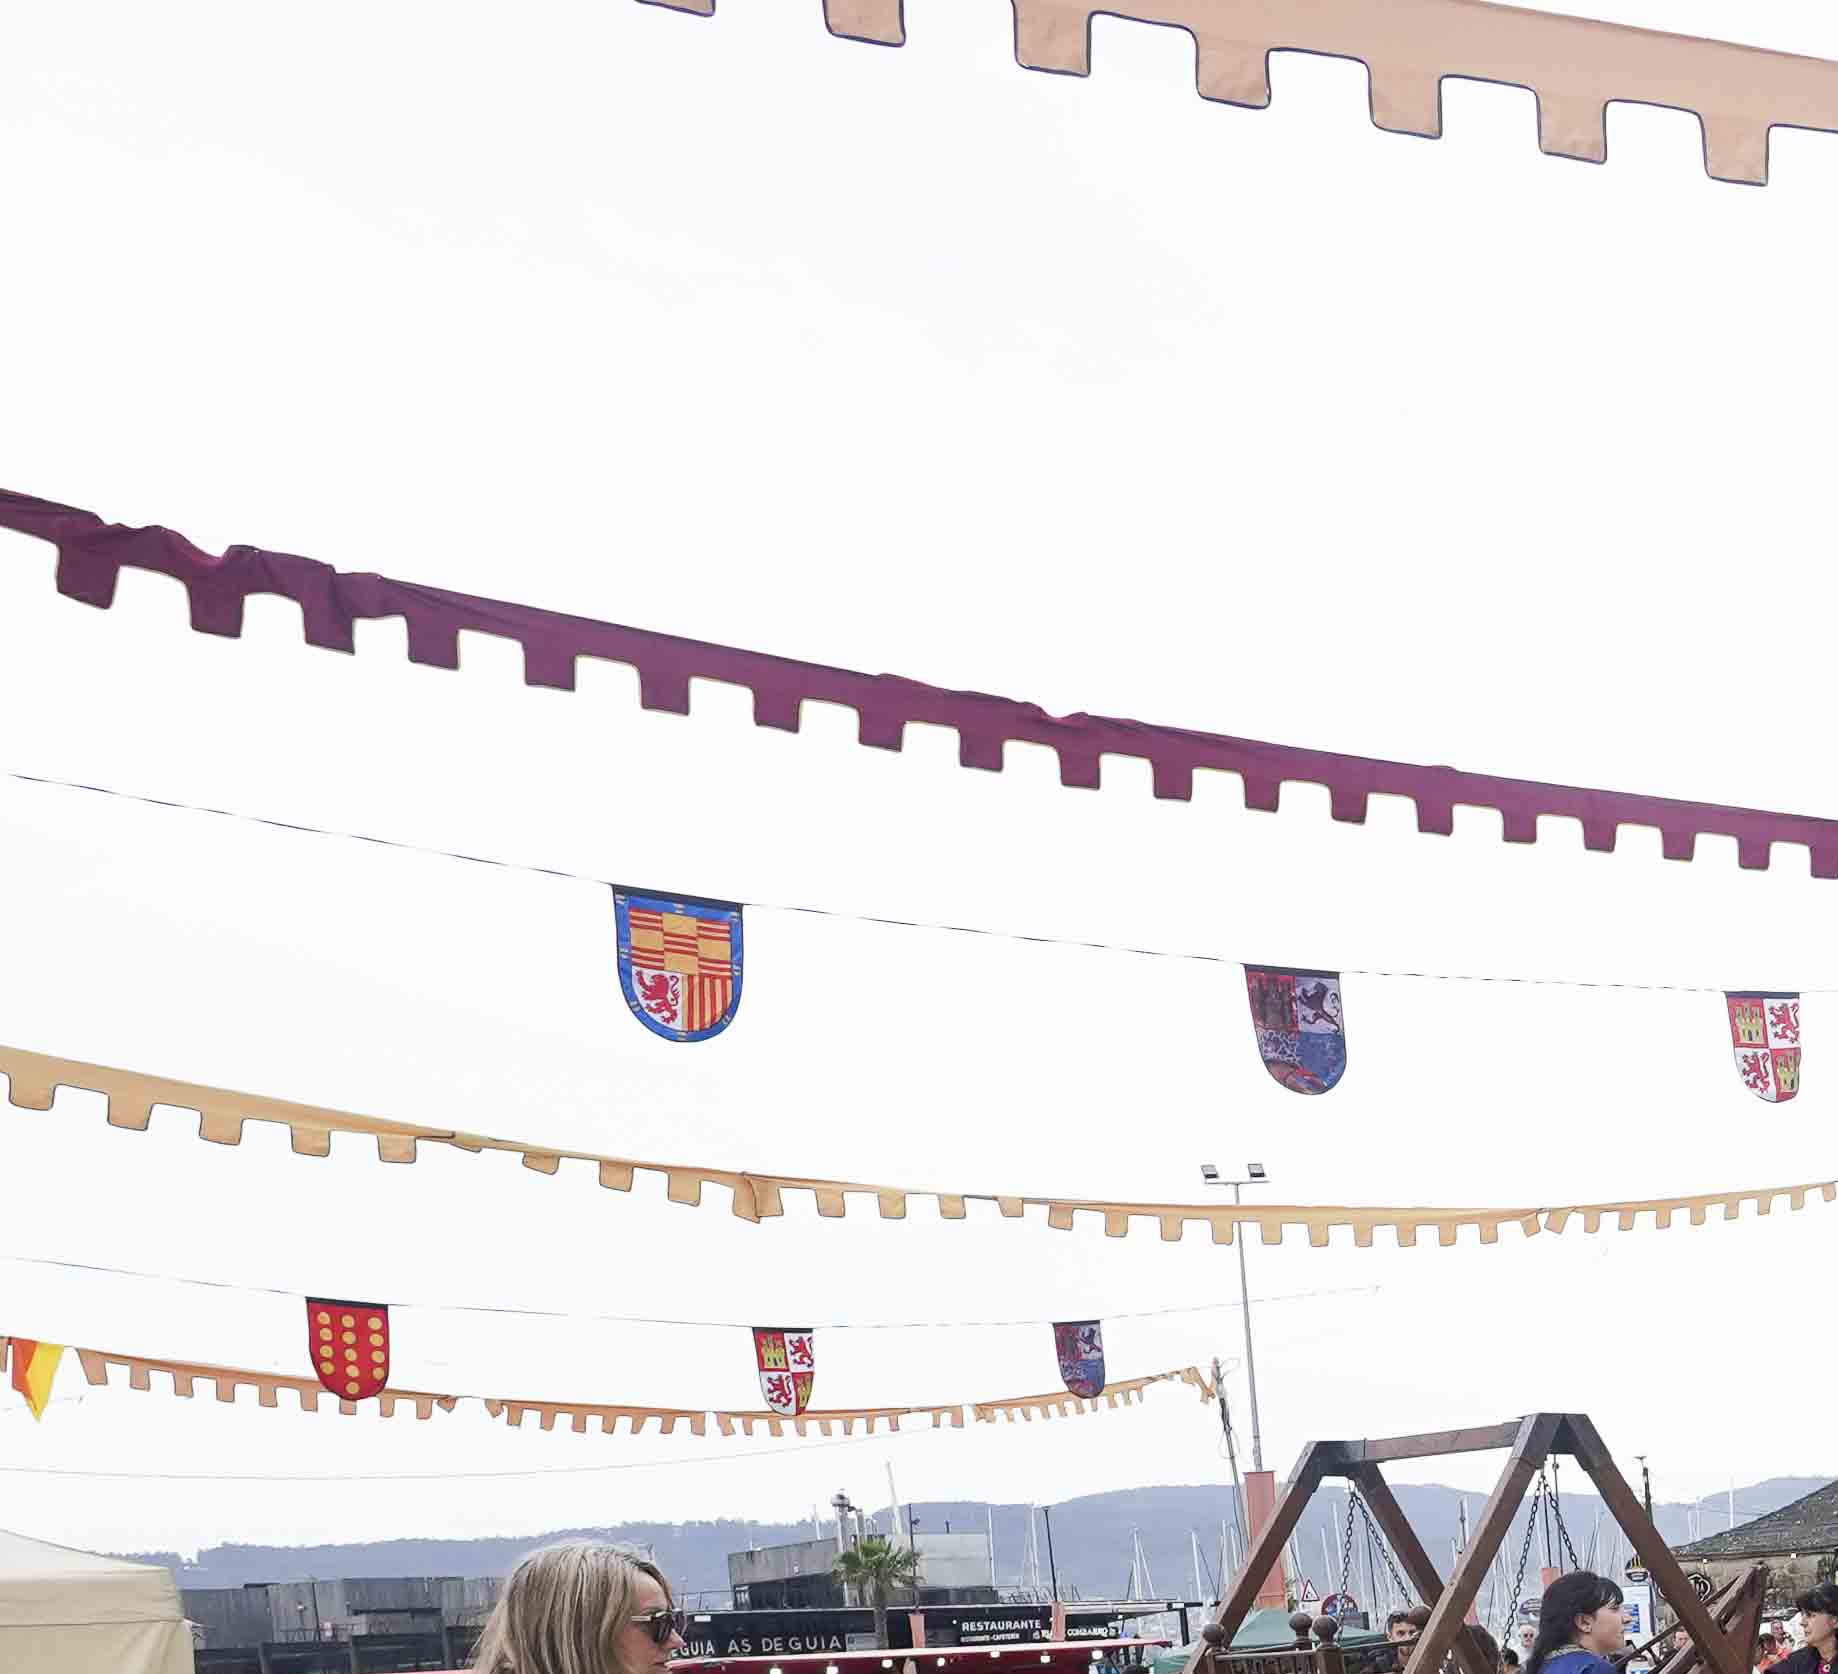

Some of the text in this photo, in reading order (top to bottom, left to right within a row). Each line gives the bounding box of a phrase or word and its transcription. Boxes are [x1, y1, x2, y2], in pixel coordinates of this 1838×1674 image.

[962, 1619, 1041, 1632] RESTAURANTE
[727, 1639, 752, 1653] AS
[788, 1634, 842, 1650] GUIA
